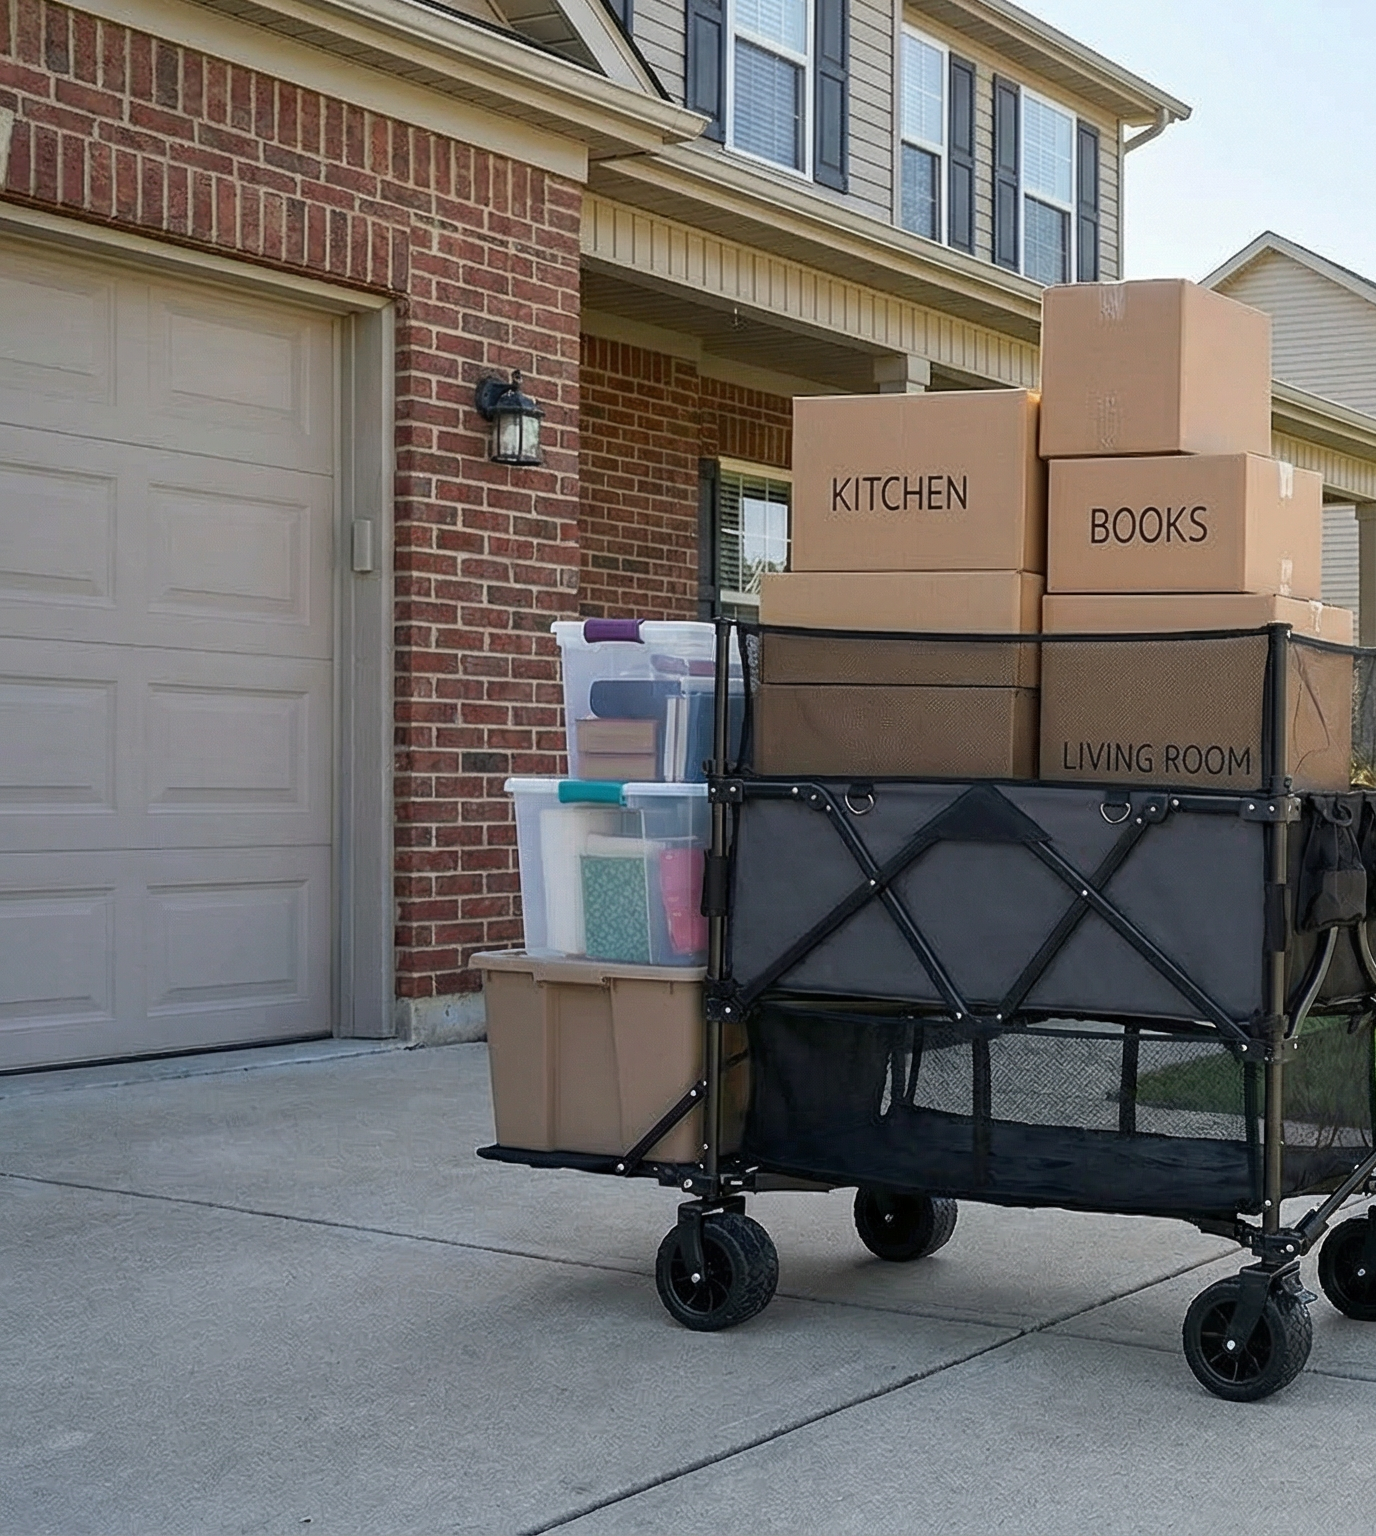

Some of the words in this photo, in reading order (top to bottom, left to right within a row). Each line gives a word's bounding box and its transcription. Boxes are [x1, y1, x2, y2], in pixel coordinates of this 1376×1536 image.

[831, 475, 968, 512] KITCHEN
[1091, 505, 1208, 544] BOOKS
[1063, 741, 1154, 774] LIVING
[1165, 745, 1251, 776] ROOM
